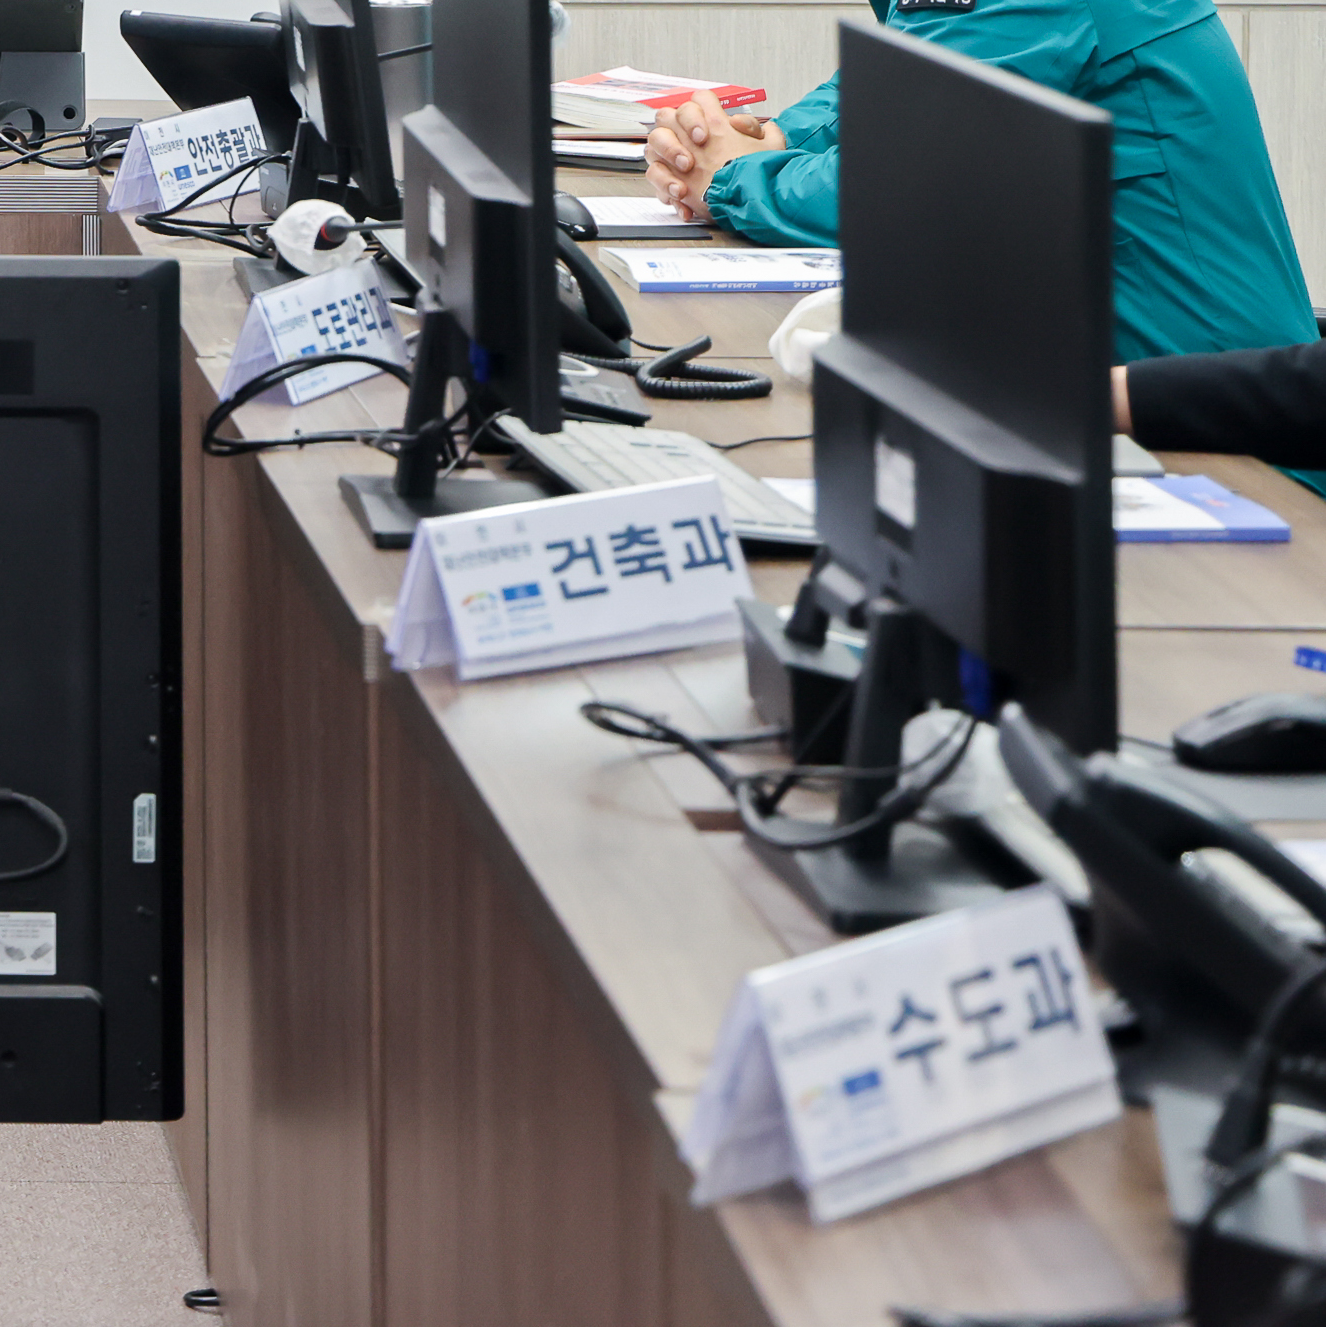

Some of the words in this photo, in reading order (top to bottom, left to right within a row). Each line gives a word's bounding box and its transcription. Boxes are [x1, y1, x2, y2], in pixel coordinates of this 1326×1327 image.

[187, 124, 261, 176] 안전총괄과
[311, 286, 396, 352] 도로관리과
[545, 514, 734, 601] 건축과
[889, 946, 1082, 1084] 수도과
